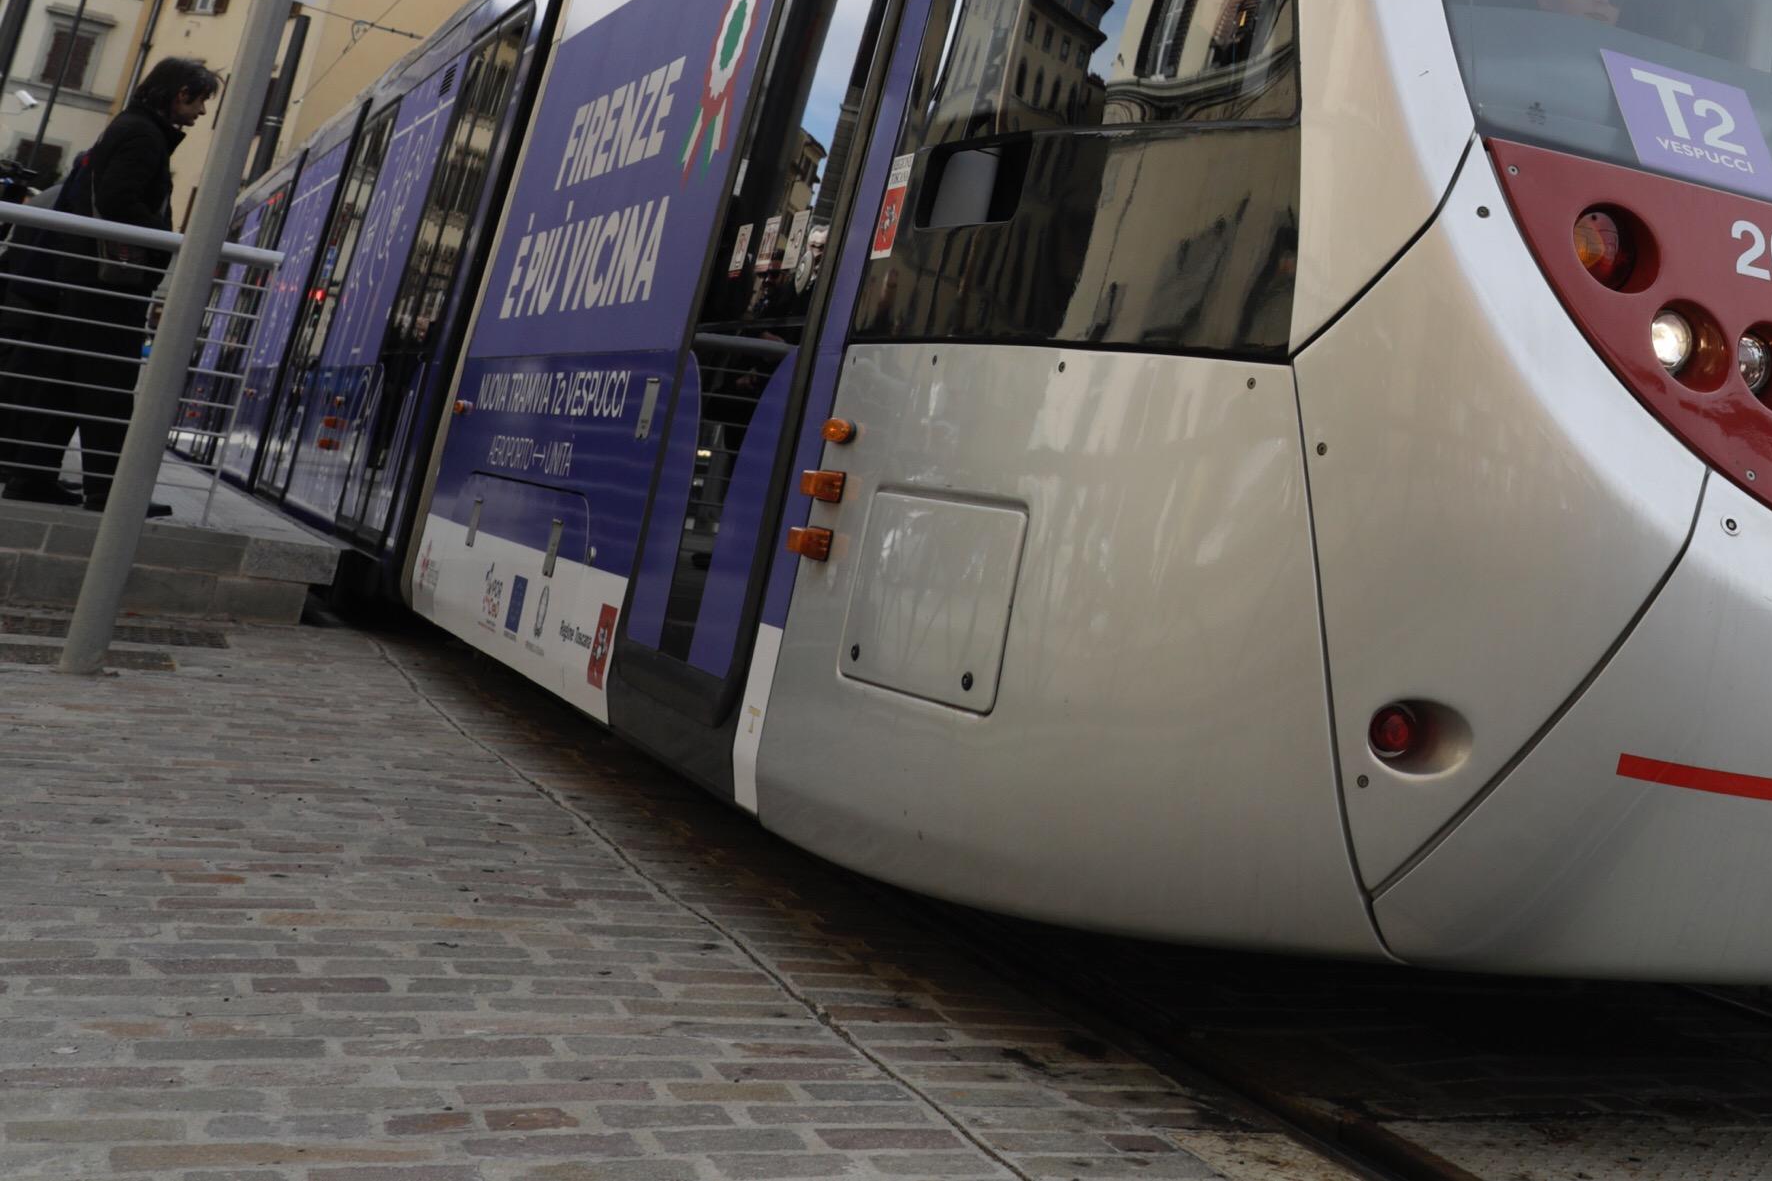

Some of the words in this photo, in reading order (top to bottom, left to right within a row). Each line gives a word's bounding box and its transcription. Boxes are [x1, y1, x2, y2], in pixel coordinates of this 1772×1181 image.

[554, 55, 687, 192] FIRENZE
[1630, 67, 1748, 156] T2
[1655, 135, 1755, 174] VESPUCCI
[559, 195, 670, 313] VICINA
[476, 372, 511, 411] NUOVA
[507, 372, 553, 415] TRAMVIA
[551, 372, 566, 415] T2
[564, 370, 632, 418] VESPUCCI
[487, 434, 534, 471] AEROPORTO
